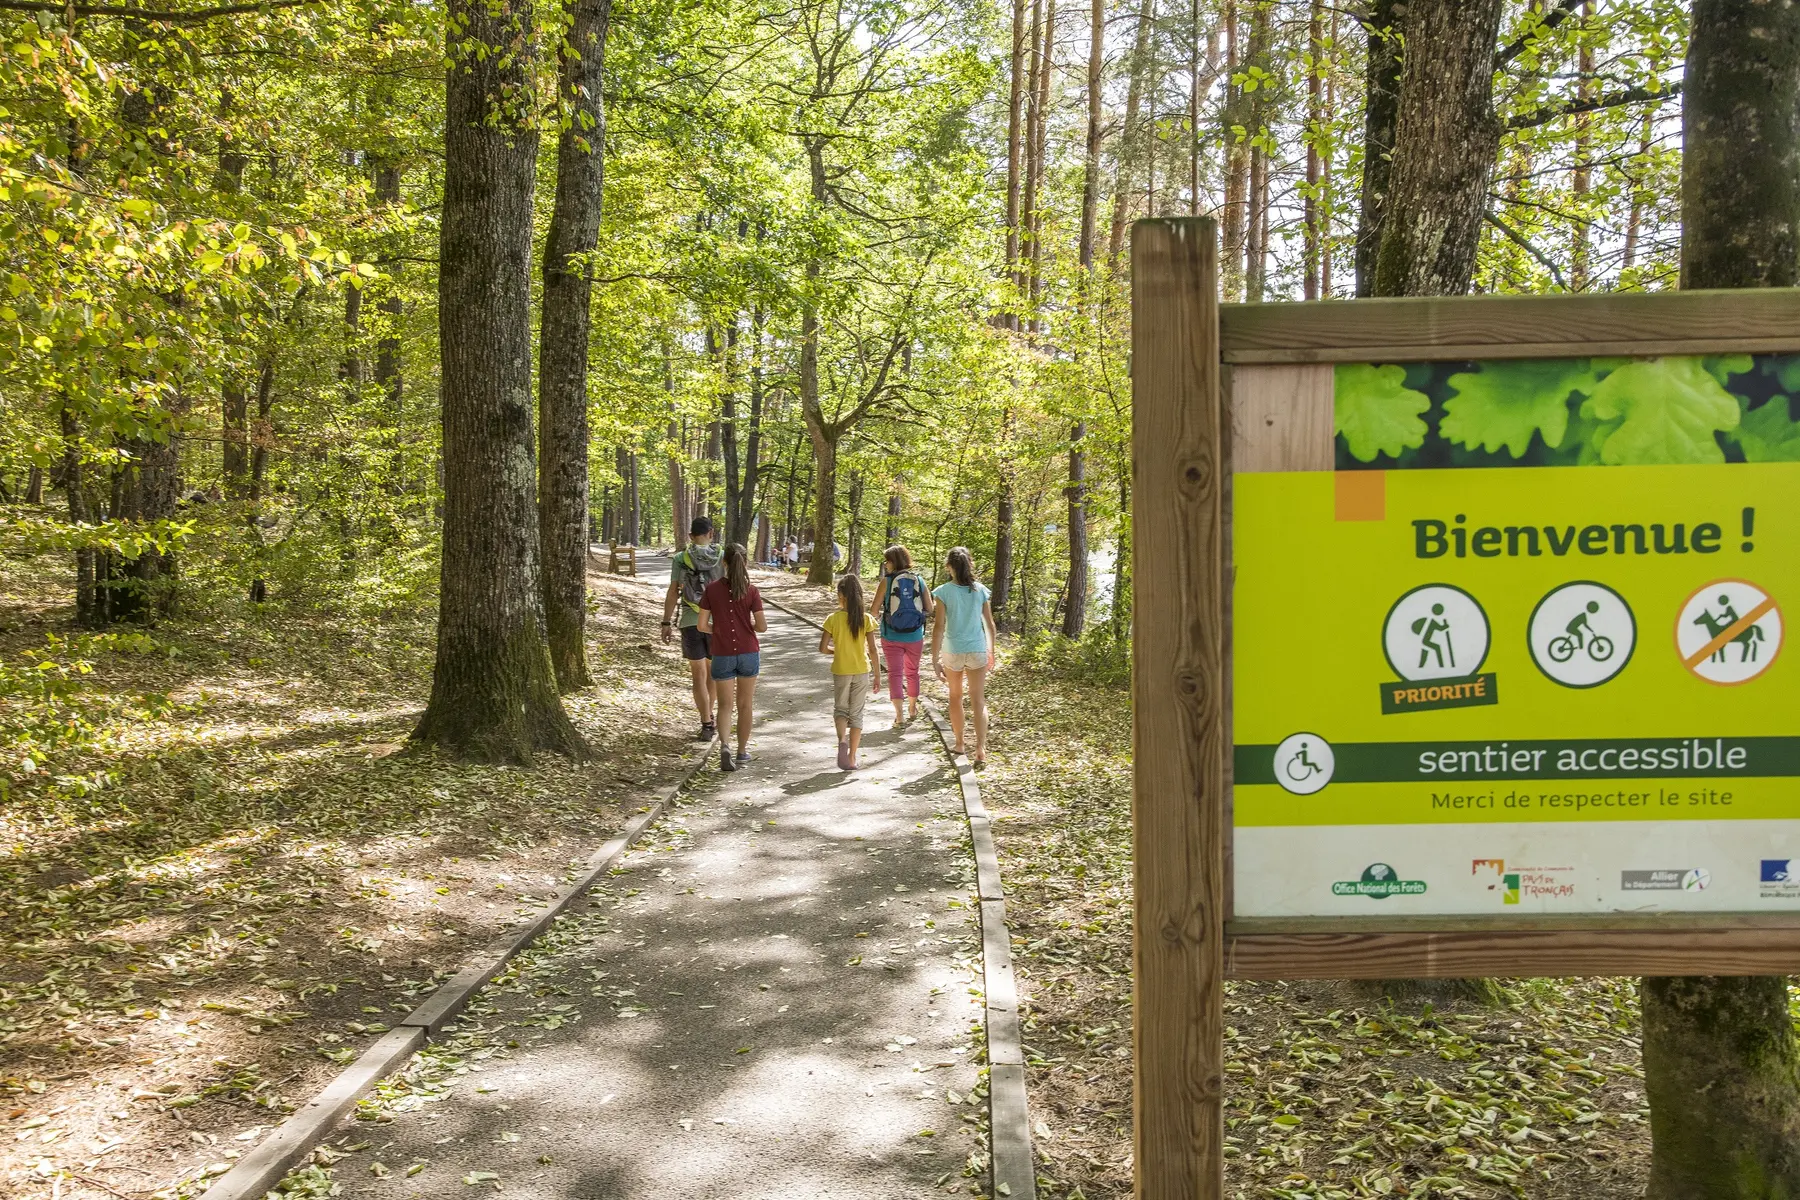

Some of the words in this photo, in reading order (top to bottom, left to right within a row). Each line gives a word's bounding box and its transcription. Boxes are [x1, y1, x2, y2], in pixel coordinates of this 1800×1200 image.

[1412, 514, 1722, 558] Bienvenue
[1741, 507, 1755, 553] !
[1393, 677, 1486, 705] PRIORITÉ
[1419, 742, 1547, 774] sentier
[1556, 739, 1747, 772] accessible
[1431, 791, 1495, 809] Merci
[1504, 790, 1531, 808] de
[1539, 791, 1651, 812] respecter
[1660, 788, 1680, 806] le
[1688, 789, 1733, 806] site
[1633, 881, 1679, 889] Département
[1650, 872, 1678, 881] Allier
[1334, 883, 1355, 894] Office
[1357, 881, 1387, 894] National
[1388, 882, 1400, 893] des
[1401, 882, 1424, 893] Forêts
[1522, 884, 1575, 898] TRONÇAIS
